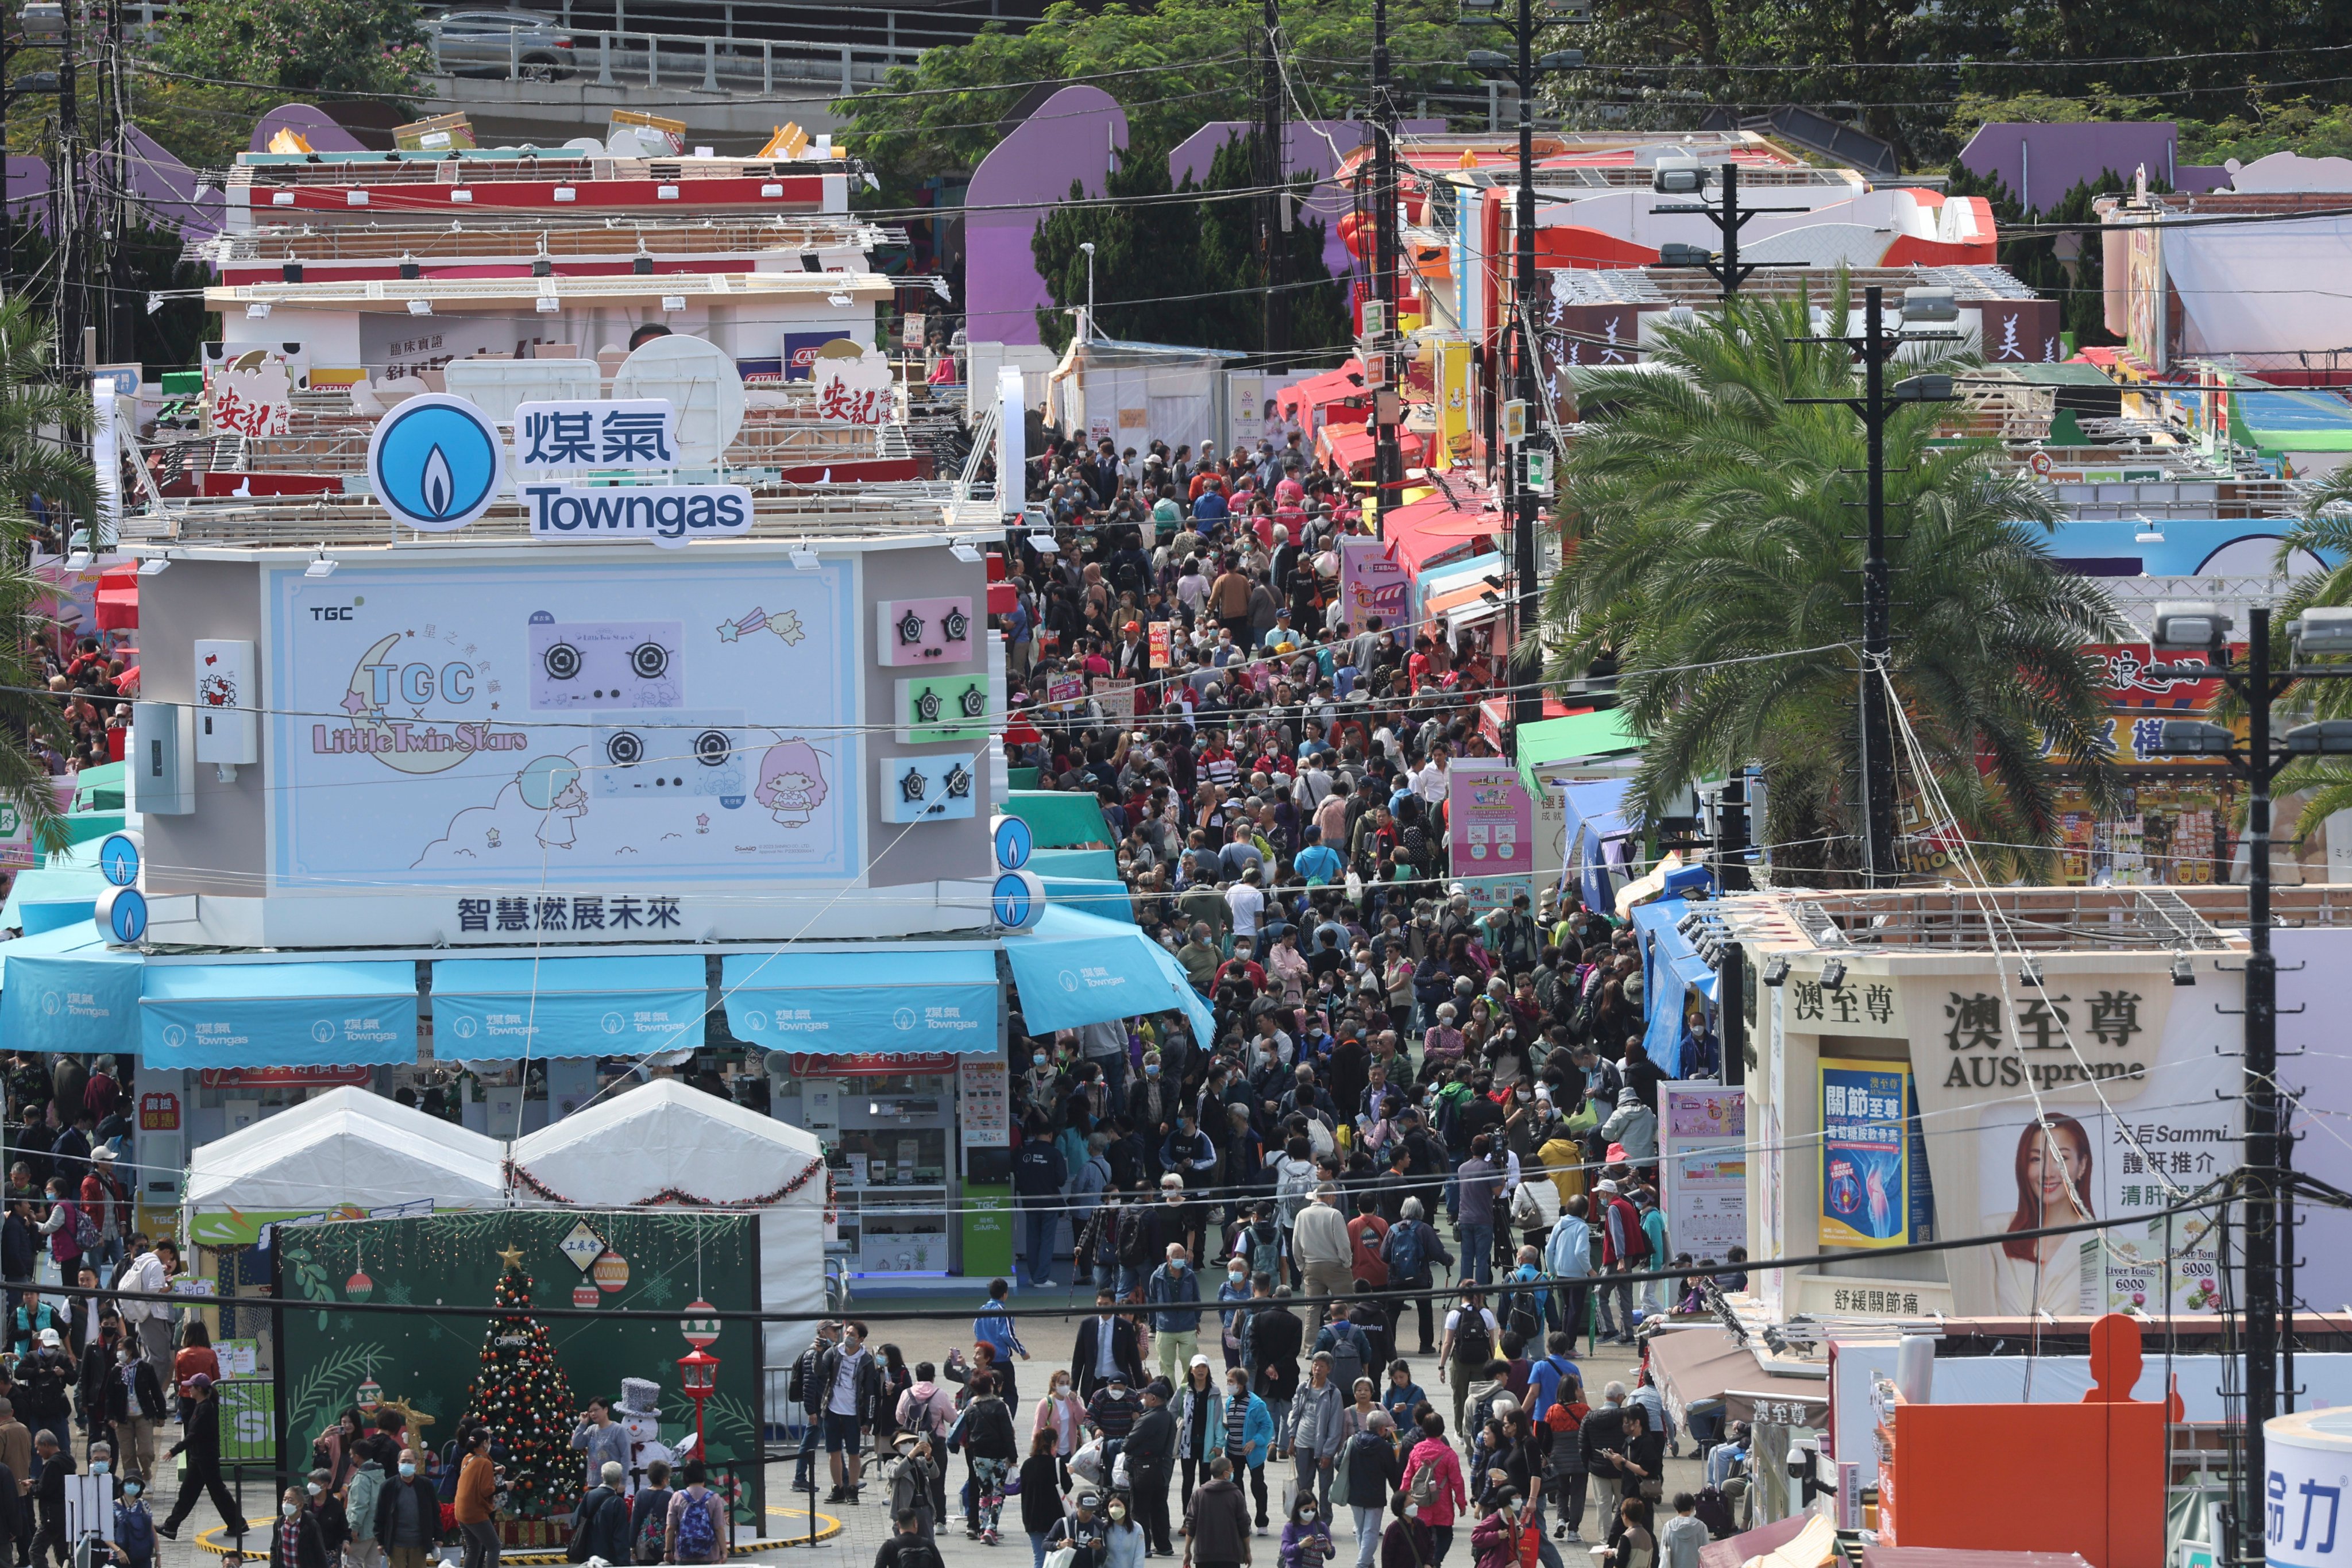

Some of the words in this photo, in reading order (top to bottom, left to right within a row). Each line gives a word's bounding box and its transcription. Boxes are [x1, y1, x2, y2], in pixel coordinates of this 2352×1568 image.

[1601, 316, 1624, 364] 美
[1999, 314, 2024, 361] 美
[390, 335, 443, 357] 臨床實證
[820, 376, 880, 424] 安記
[880, 388, 894, 423] 海味
[213, 387, 270, 437] 安記
[526, 411, 671, 464] 煤氣
[526, 487, 745, 536] Towngas
[310, 607, 353, 621] TGC
[363, 661, 475, 705] TGC
[457, 895, 682, 932] 智慧燃展未來
[1080, 967, 1109, 978] 煤氣
[1086, 976, 1126, 988] Towngas
[67, 993, 95, 1006] 煤氣
[1794, 979, 1894, 1024] 澳至尊
[68, 1005, 110, 1018] Towngas
[633, 1011, 668, 1023] 煤氣
[775, 1009, 812, 1020] 煤氣
[925, 1007, 961, 1018] 煤氣
[344, 1018, 380, 1030] 煤氣
[485, 1014, 522, 1025] 煤氣
[775, 1020, 829, 1032] Towngas
[925, 1019, 979, 1030] Towngas
[1944, 990, 2142, 1051] 澳至尊
[195, 1022, 231, 1034] 煤氣
[486, 1025, 539, 1036] Towngas
[633, 1022, 685, 1033] Towngas
[195, 1035, 248, 1046] Towngas
[344, 1031, 397, 1042] Towngas
[1944, 1056, 2145, 1091] AUSupreme
[1870, 1077, 1898, 1089] 澳至尊
[146, 1098, 172, 1111] 震撼
[1826, 1086, 1899, 1119] 關節至尊
[144, 1112, 175, 1128] 優惠
[1826, 1117, 1848, 1125] SUPER
[2123, 1151, 2215, 1175] 護肝推介
[975, 1201, 999, 1209] TGC
[152, 1216, 175, 1224] TGC
[566, 1240, 598, 1253] 工展會
[2106, 1266, 2127, 1277] Liver
[2131, 1266, 2155, 1277] Tonic
[2182, 1262, 2214, 1276] 6000
[185, 1286, 205, 1295] 出口
[2115, 1279, 2146, 1291] 6000
[1834, 1289, 1918, 1314] 舒緩關節痛
[1753, 1400, 1806, 1424] 澳至尊
